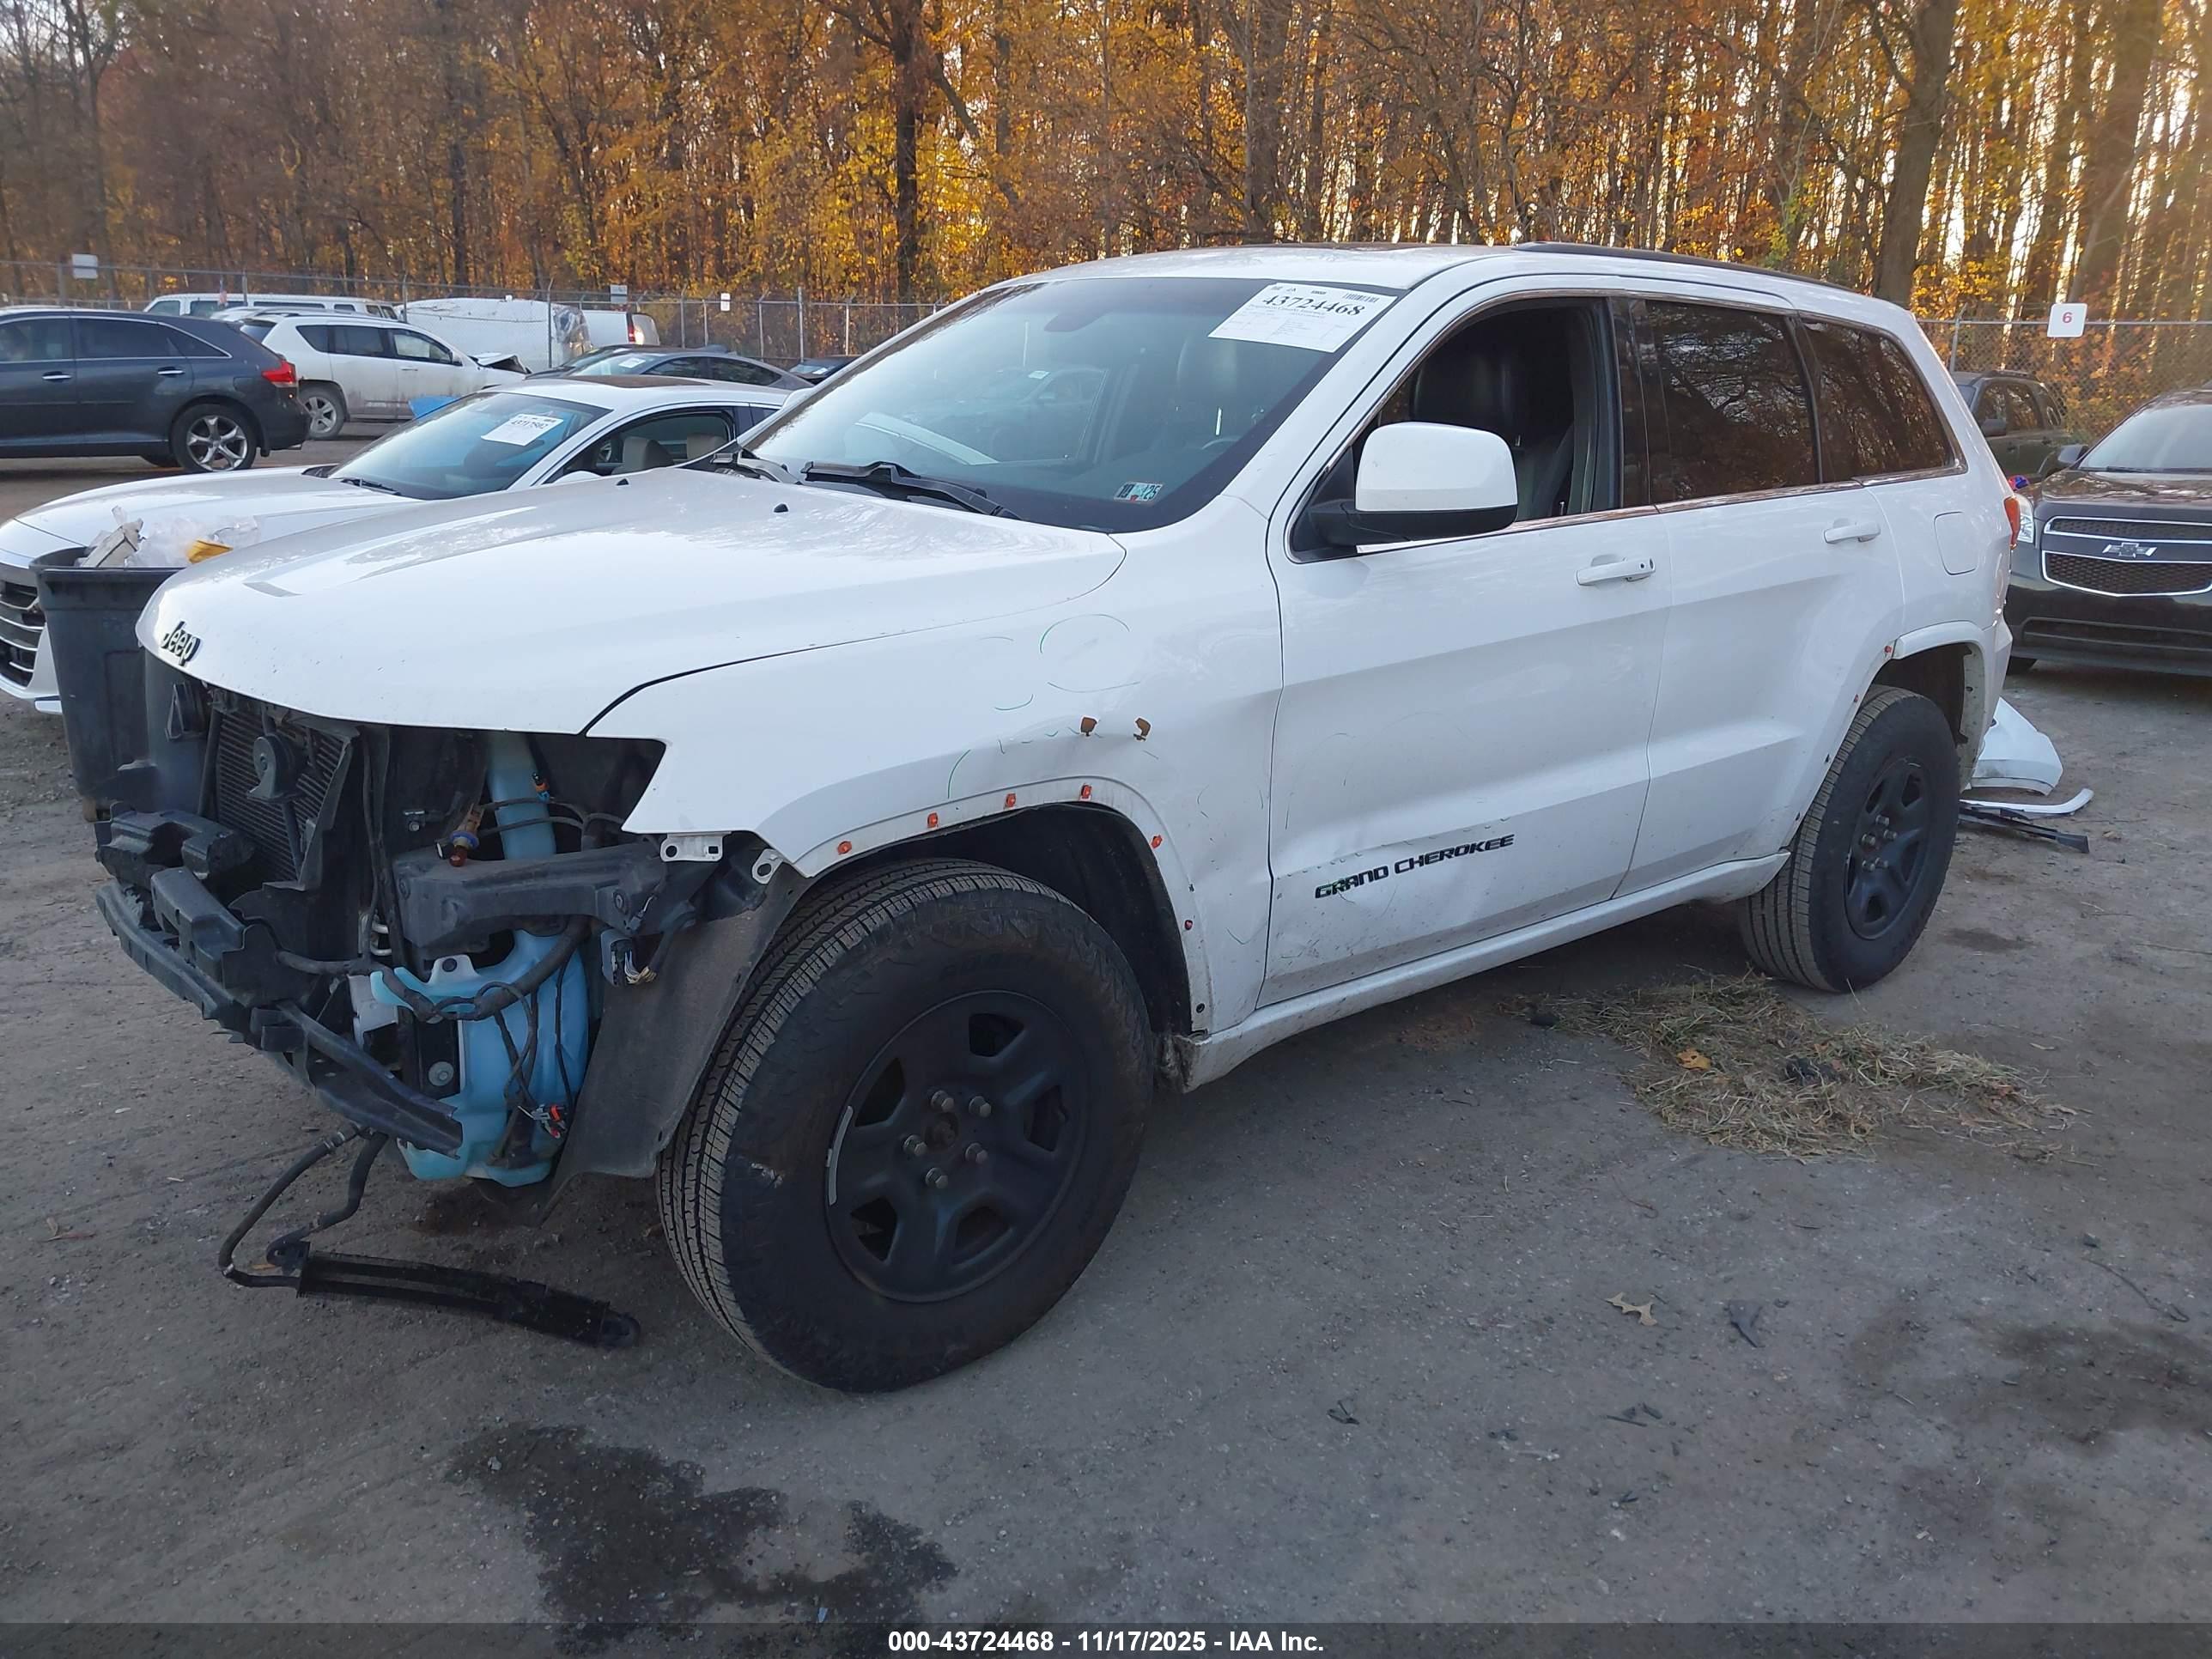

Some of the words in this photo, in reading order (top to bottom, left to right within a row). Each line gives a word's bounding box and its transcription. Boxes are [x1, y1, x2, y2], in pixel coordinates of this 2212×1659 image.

[1262, 295, 1365, 316] 43724468
[2063, 312, 2072, 324] 6
[161, 620, 202, 667] Jeep
[1315, 866, 1389, 899] GRAND
[1395, 834, 1515, 874] CHEROKEE
